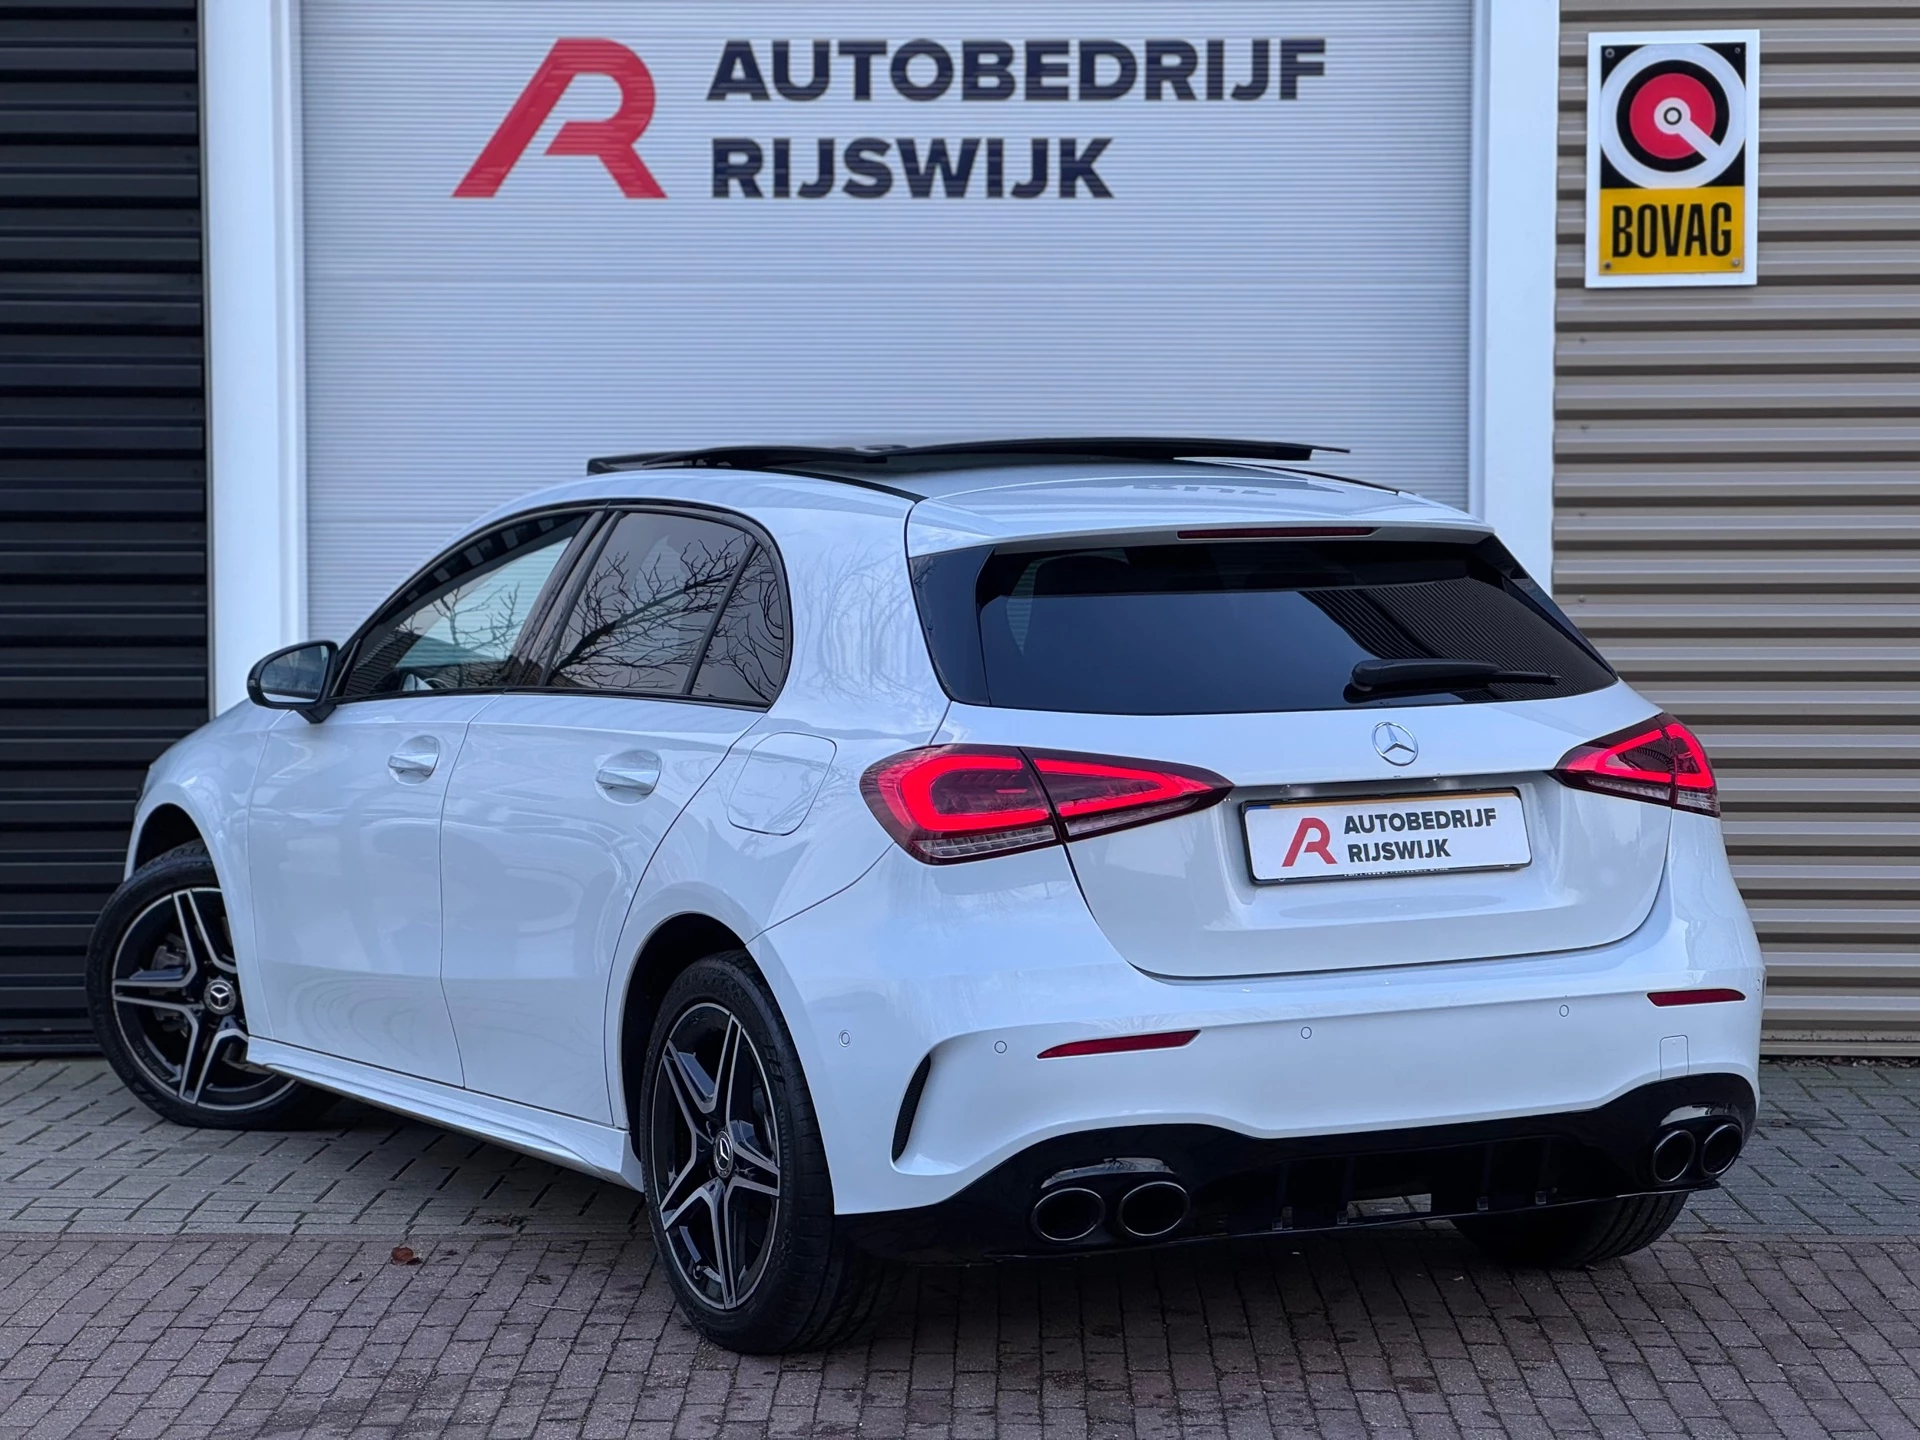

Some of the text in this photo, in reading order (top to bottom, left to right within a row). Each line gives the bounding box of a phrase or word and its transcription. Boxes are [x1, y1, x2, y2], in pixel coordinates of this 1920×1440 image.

[706, 39, 1326, 102] AUTOBEDRIJF
[712, 138, 1114, 199] RIJSWIJK
[1612, 202, 1732, 258] BOVAG
[1344, 808, 1497, 835] AUTOBEDRIJF
[1347, 838, 1451, 863] RIJSWIJK
